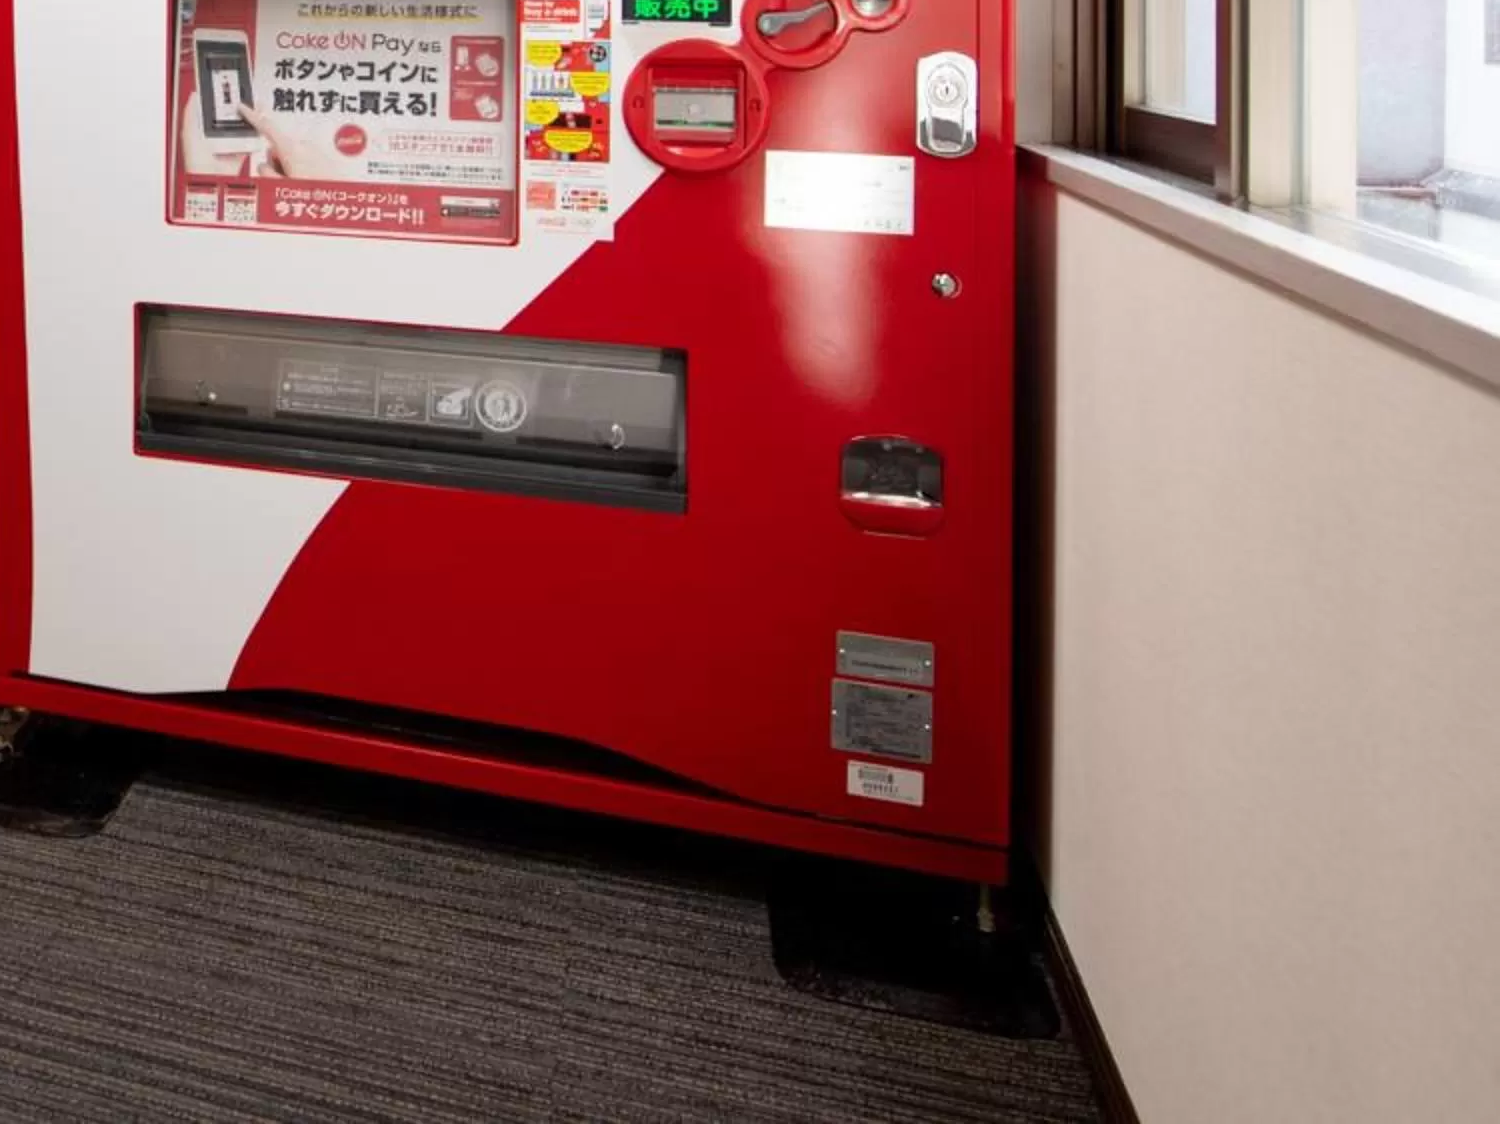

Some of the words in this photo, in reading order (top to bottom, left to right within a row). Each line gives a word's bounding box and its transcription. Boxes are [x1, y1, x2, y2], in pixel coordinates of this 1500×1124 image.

[275, 31, 329, 49] Coke
[333, 30, 367, 50] ON
[274, 58, 439, 84] ボタンやコインに
[272, 88, 438, 118] 触れずに買える!
[274, 200, 426, 226] 今すぐダウンロード!!
